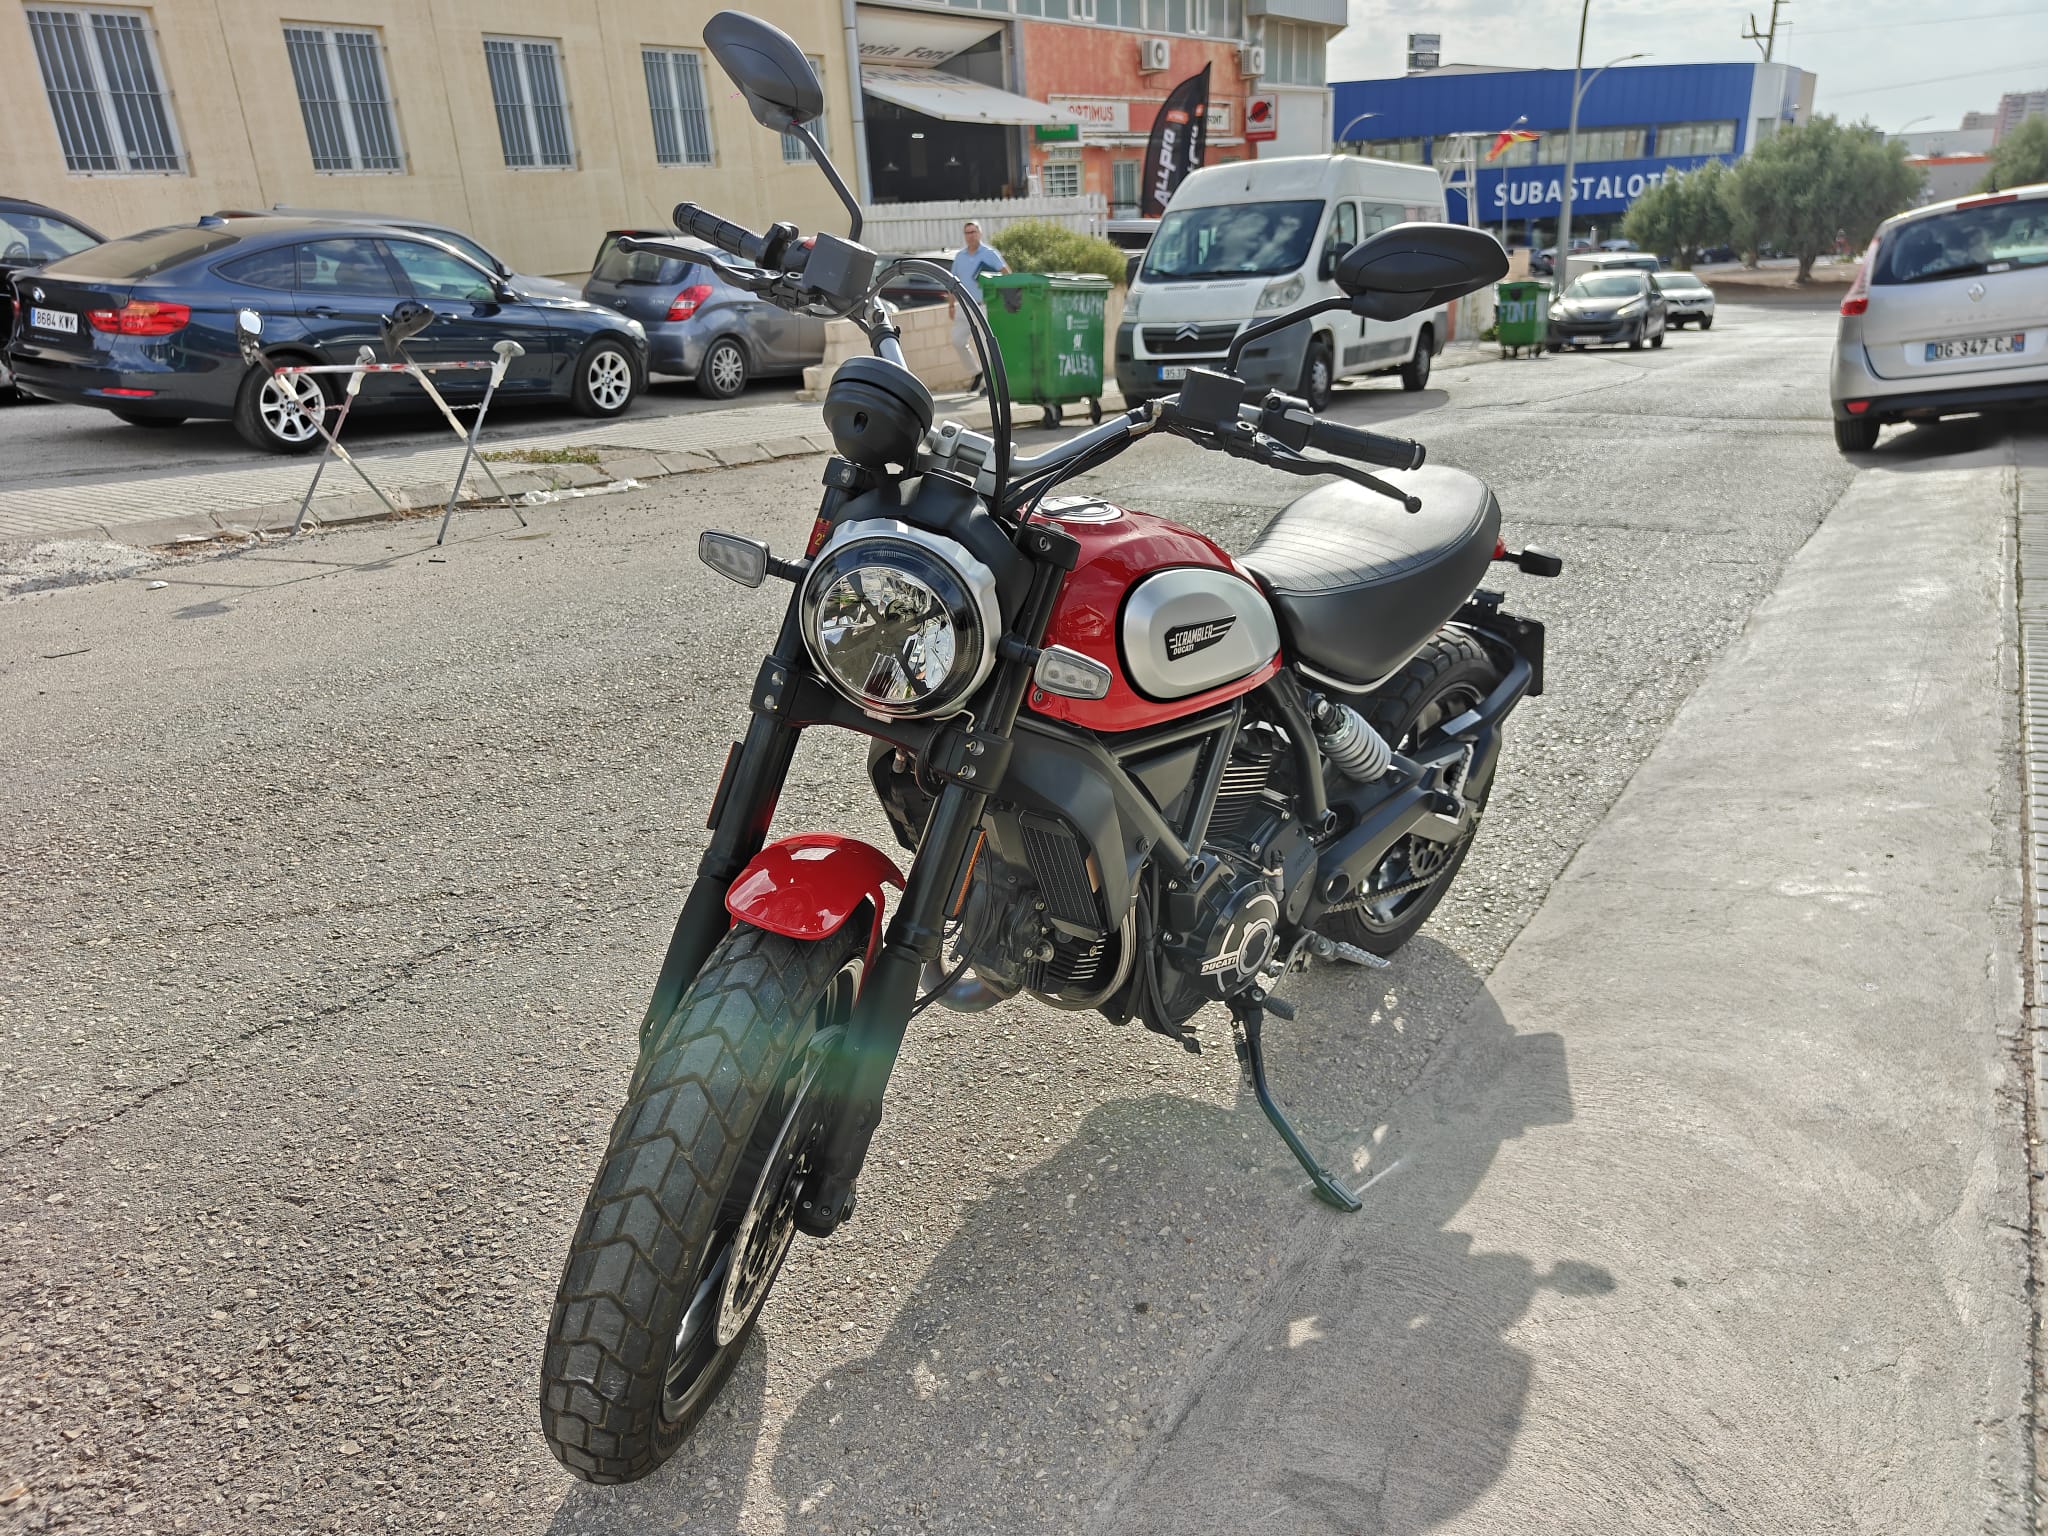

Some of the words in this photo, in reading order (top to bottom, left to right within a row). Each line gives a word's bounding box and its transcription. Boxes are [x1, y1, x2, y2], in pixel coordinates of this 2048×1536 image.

[1174, 624, 1214, 647] SCRAMBLER
[1173, 643, 1195, 656] DUCATI
[1201, 956, 1237, 973] DUCATI
